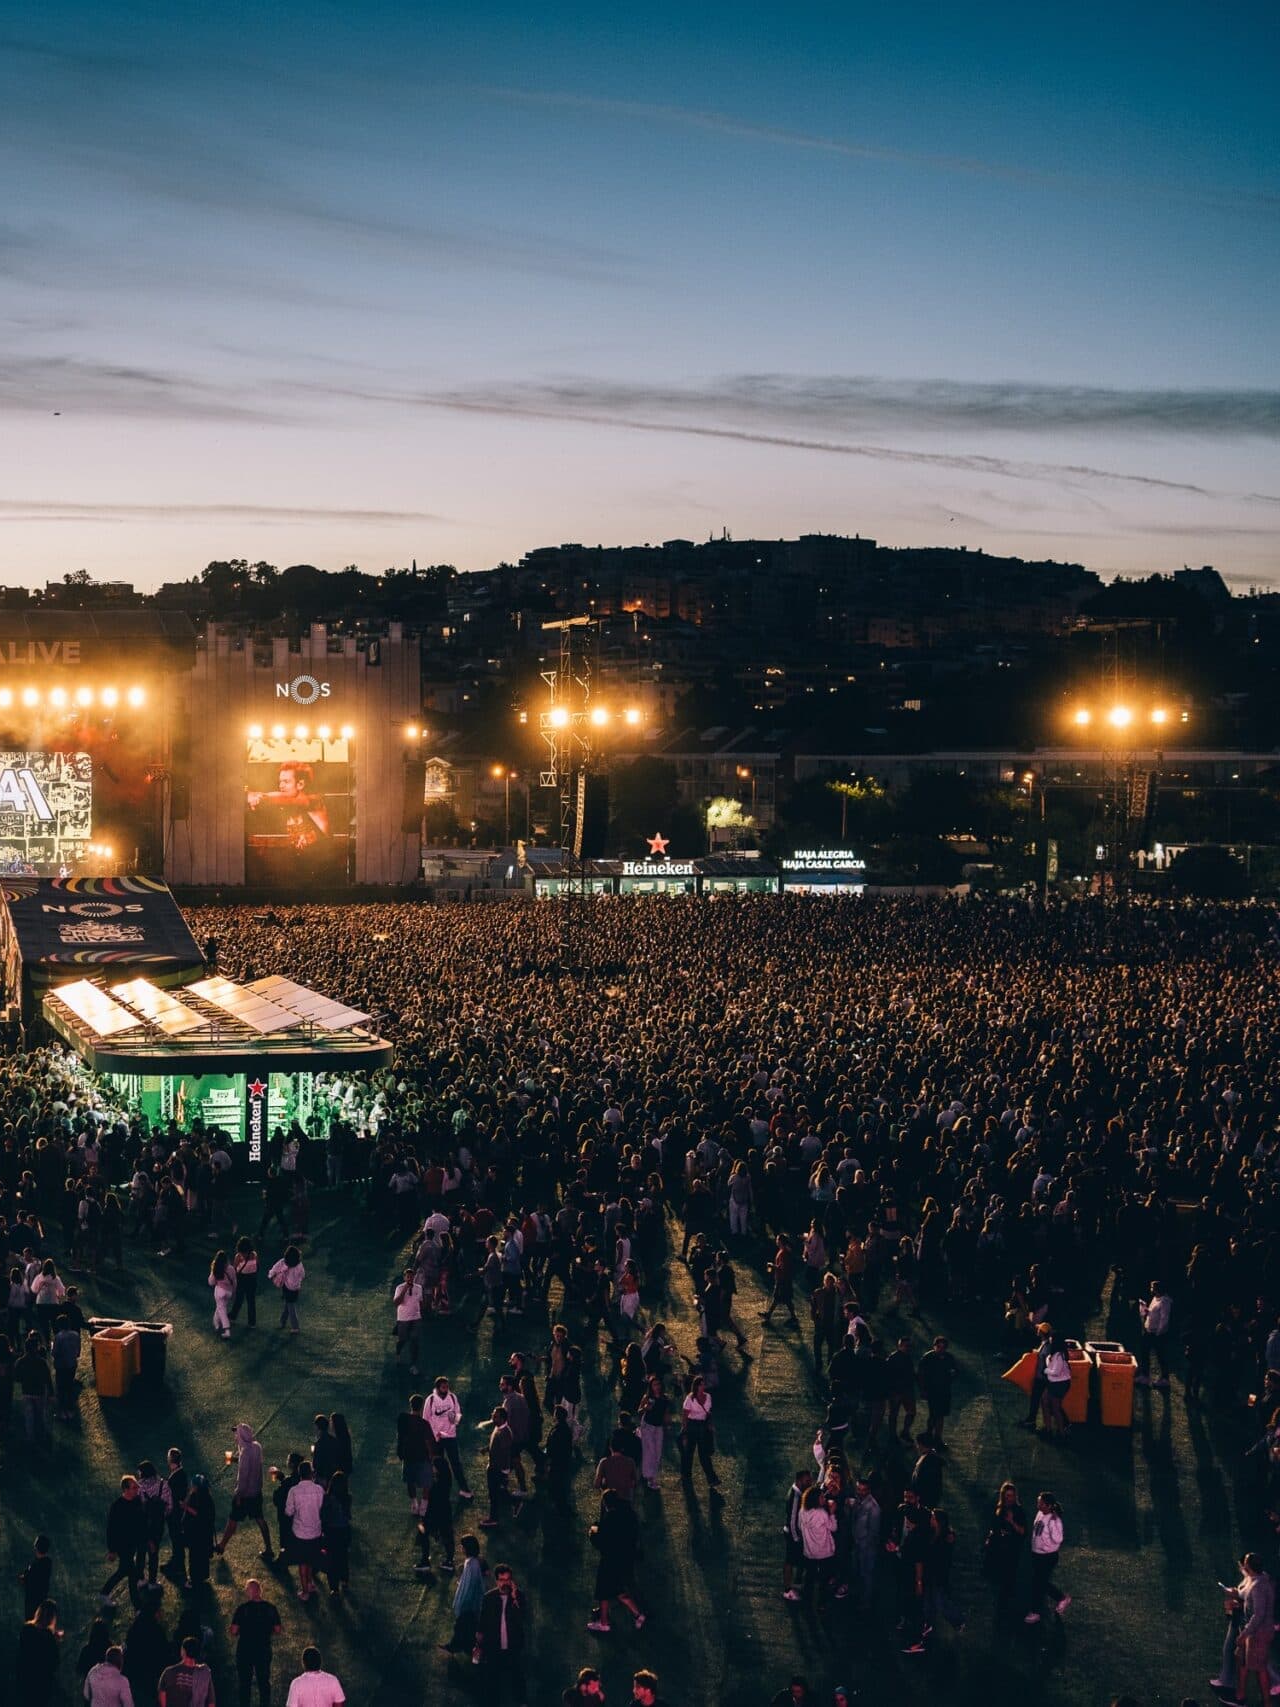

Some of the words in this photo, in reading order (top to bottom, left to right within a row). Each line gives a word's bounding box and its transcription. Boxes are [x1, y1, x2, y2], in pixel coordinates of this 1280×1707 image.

[276, 675, 331, 705] NOS
[794, 850, 816, 860] HAJA
[817, 850, 854, 859] ALEGRIA
[622, 861, 695, 875] Heineken
[783, 860, 805, 870] HAJA
[805, 860, 832, 869] CASAL
[833, 860, 866, 869] GARCIA
[42, 902, 145, 917] NOS
[249, 1098, 262, 1161] Heineken
